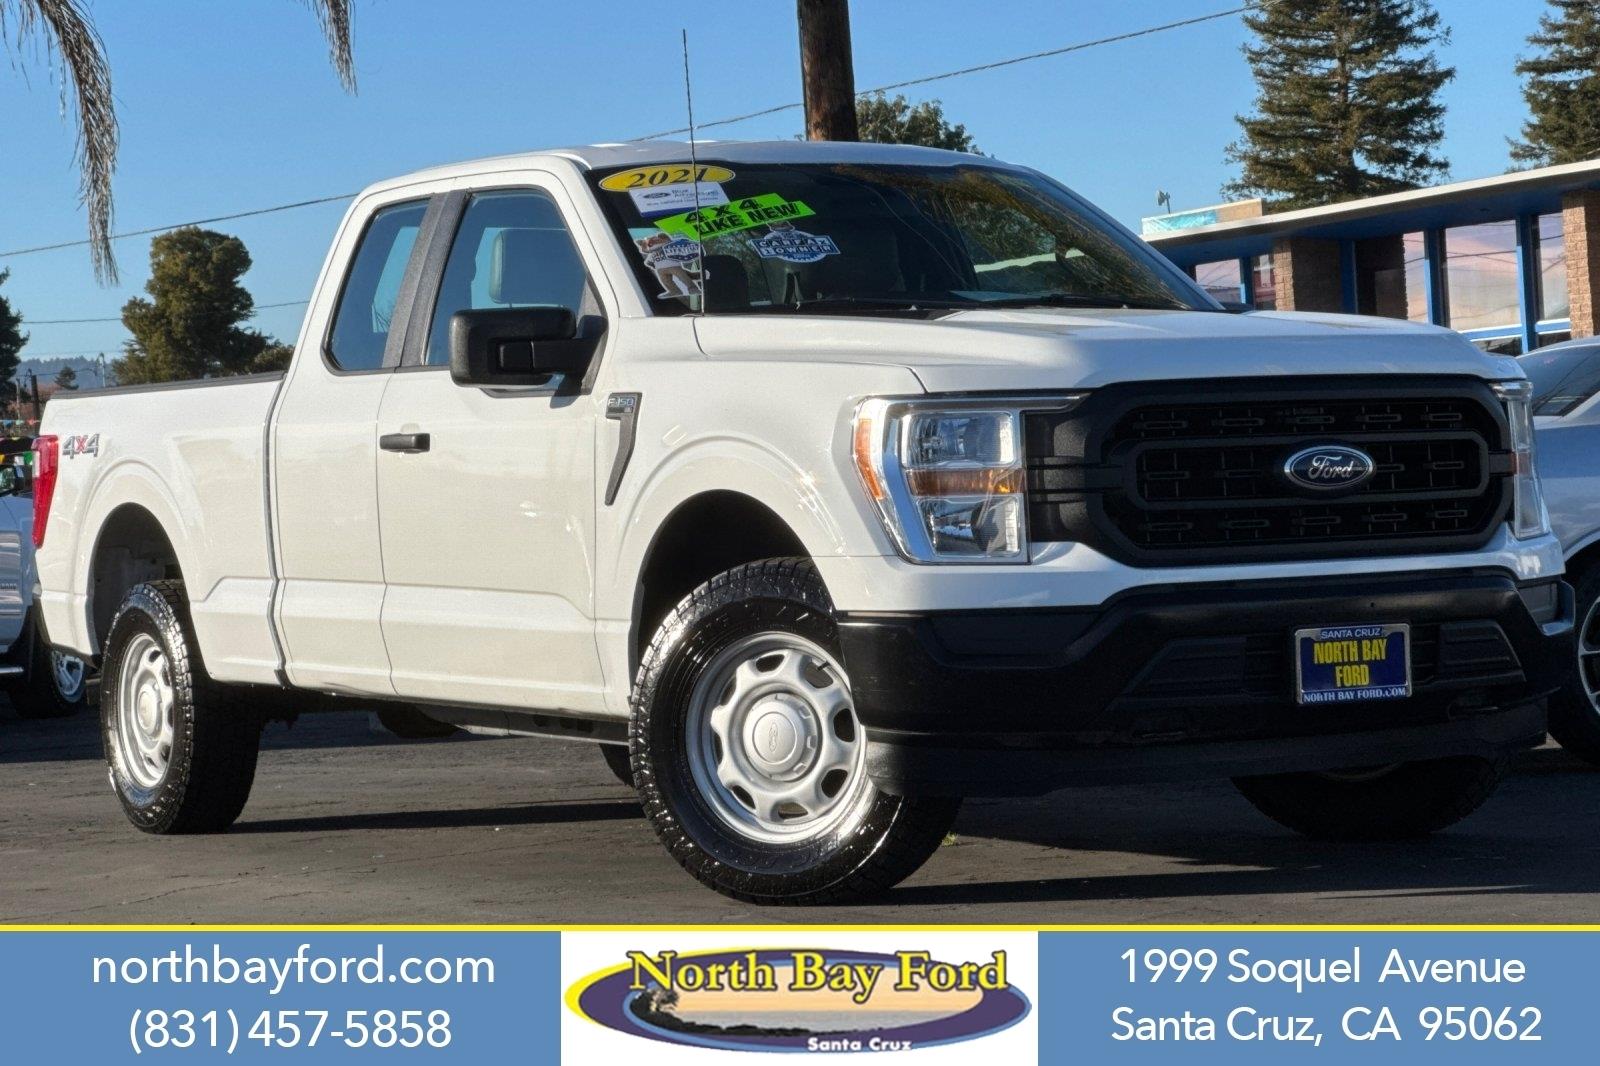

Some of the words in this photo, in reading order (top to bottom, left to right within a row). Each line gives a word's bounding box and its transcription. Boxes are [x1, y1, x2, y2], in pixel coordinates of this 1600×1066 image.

[625, 167, 708, 188] 2021
[739, 198, 761, 210] 4
[692, 213, 748, 235] LIKE
[747, 201, 799, 223] NEW
[1308, 455, 1354, 480] Ford
[1320, 629, 1353, 640] SANTA
[1354, 627, 1382, 638] CRUZ
[1313, 640, 1359, 664] NORTH
[1361, 638, 1388, 661] BAY
[1335, 664, 1370, 688] FORD
[1303, 691, 1335, 703] NORTH
[1337, 690, 1355, 701] BAY
